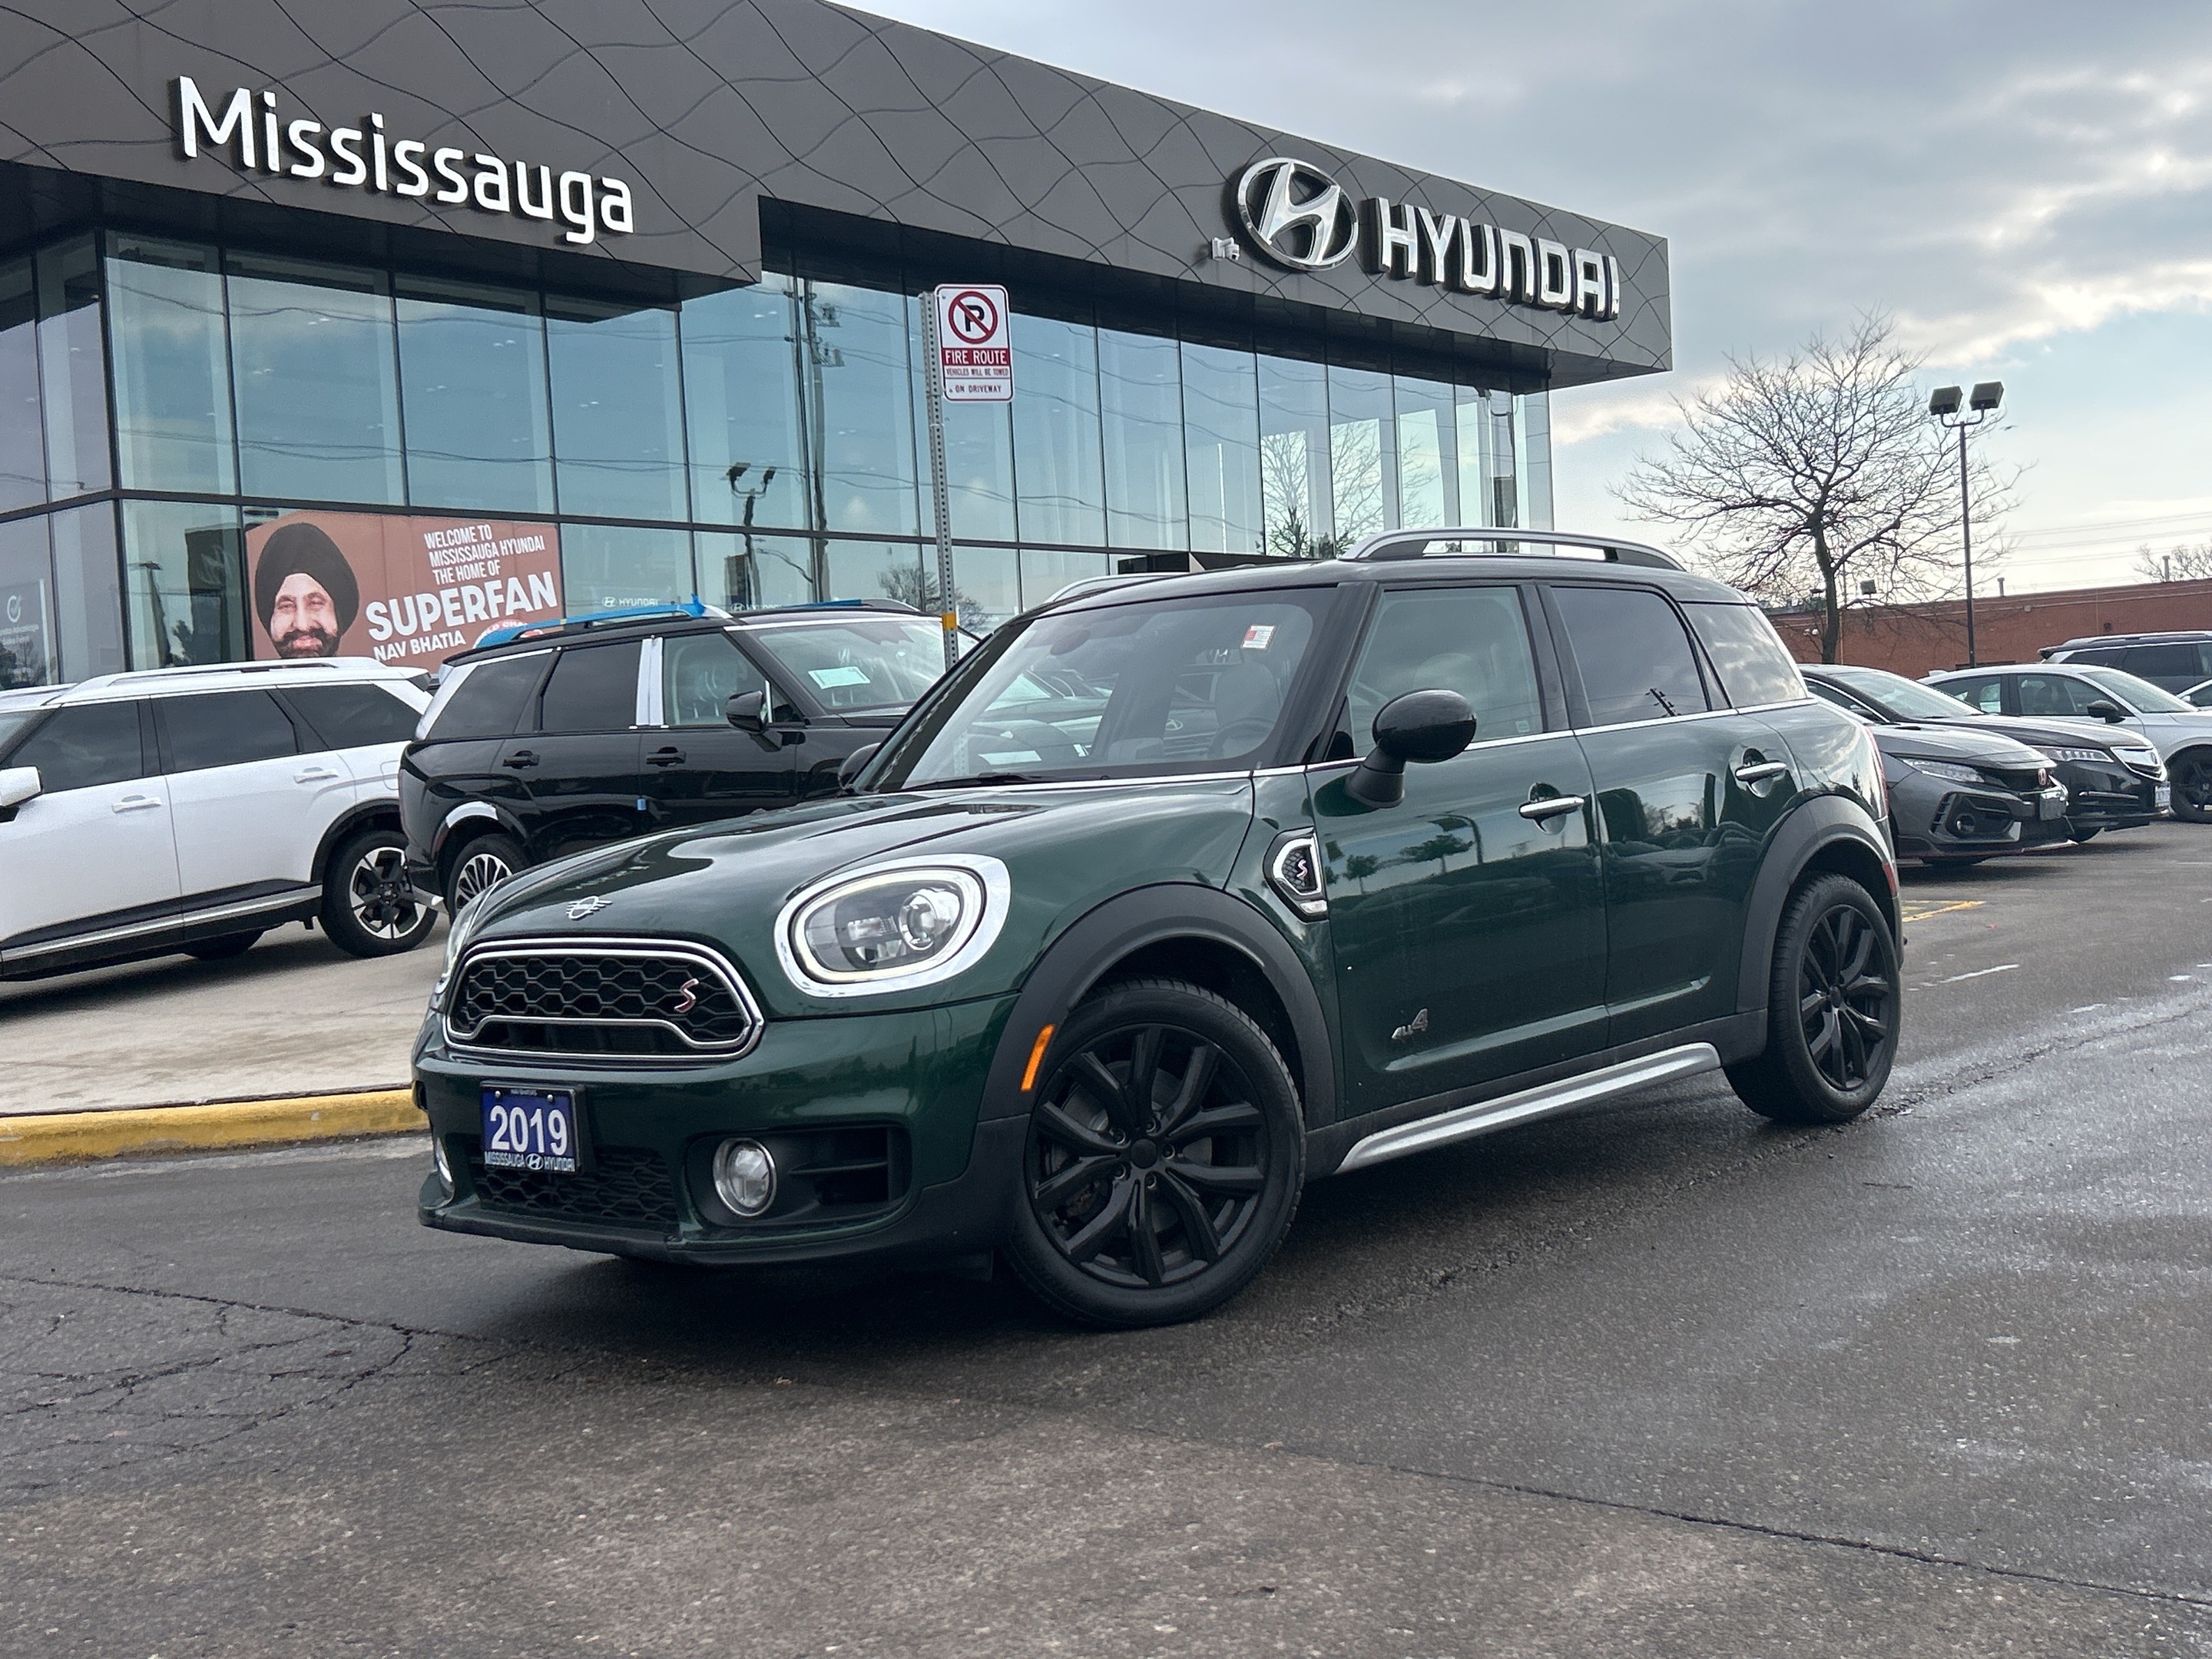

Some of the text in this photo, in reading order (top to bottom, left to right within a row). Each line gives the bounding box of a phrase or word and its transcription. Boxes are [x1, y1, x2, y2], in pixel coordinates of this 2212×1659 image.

[178, 75, 634, 245] Mississauga
[1376, 197, 1621, 320] HYUNDAI
[945, 349, 1008, 365] FIRE ROUTE
[945, 368, 1009, 376] VEHICLES WILL BE TOWED
[955, 384, 1002, 393] ON DRIVEWAY
[424, 524, 493, 549] WELCOME TO
[429, 535, 546, 568] MISSISSAUGA HYUNDAI
[432, 559, 501, 585] THE HOME OF
[366, 571, 558, 641] SUPERFAN
[373, 630, 467, 662] NAV BHATIA
[489, 1104, 568, 1156] 2019
